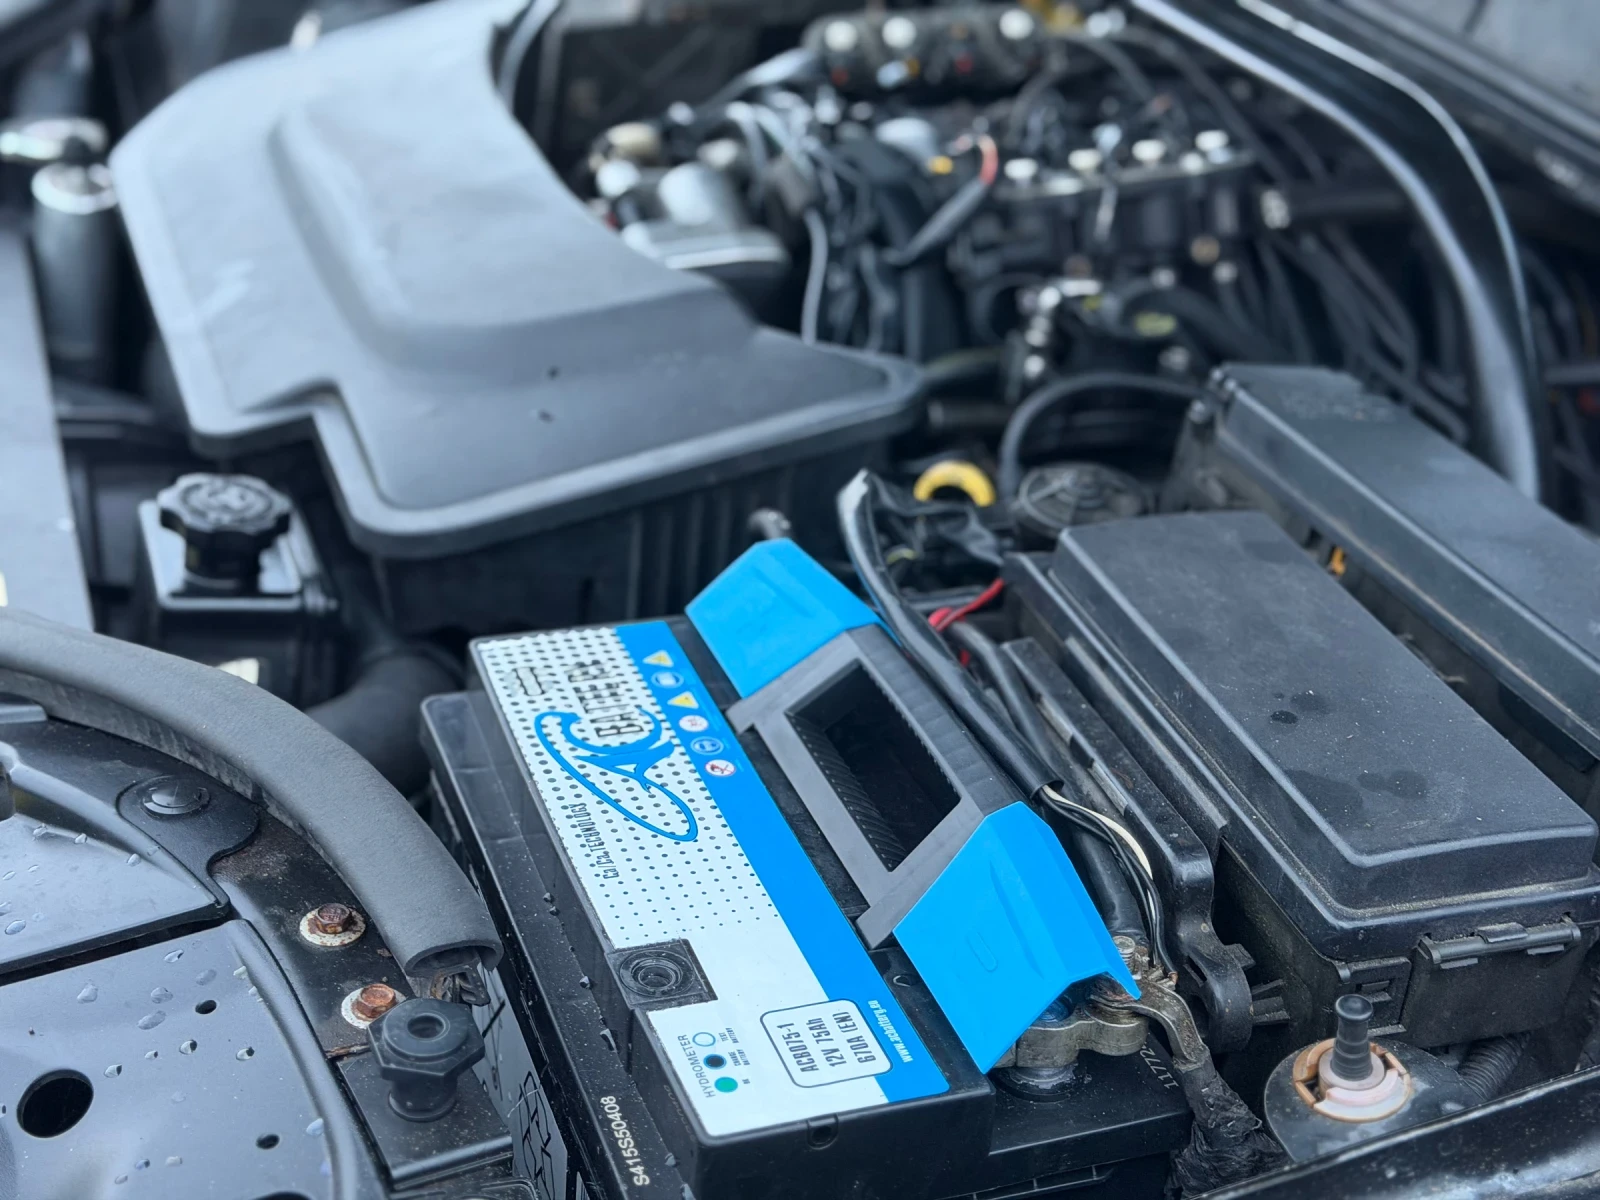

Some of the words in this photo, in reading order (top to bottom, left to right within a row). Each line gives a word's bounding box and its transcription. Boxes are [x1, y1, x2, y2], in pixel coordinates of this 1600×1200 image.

[569, 802, 605, 852] TECHNOLOGY
[777, 1022, 820, 1073] ACB075-1
[805, 1017, 835, 1045] 75Ah
[832, 1011, 858, 1037] (EN)
[867, 1000, 913, 1063] www.acbattery.eu
[677, 1034, 716, 1098] HYDROMETER
[822, 1047, 848, 1067] 12V
[846, 1035, 877, 1064] 670A
[1140, 1043, 1179, 1089] 11772
[600, 1095, 650, 1187] S415S50408
